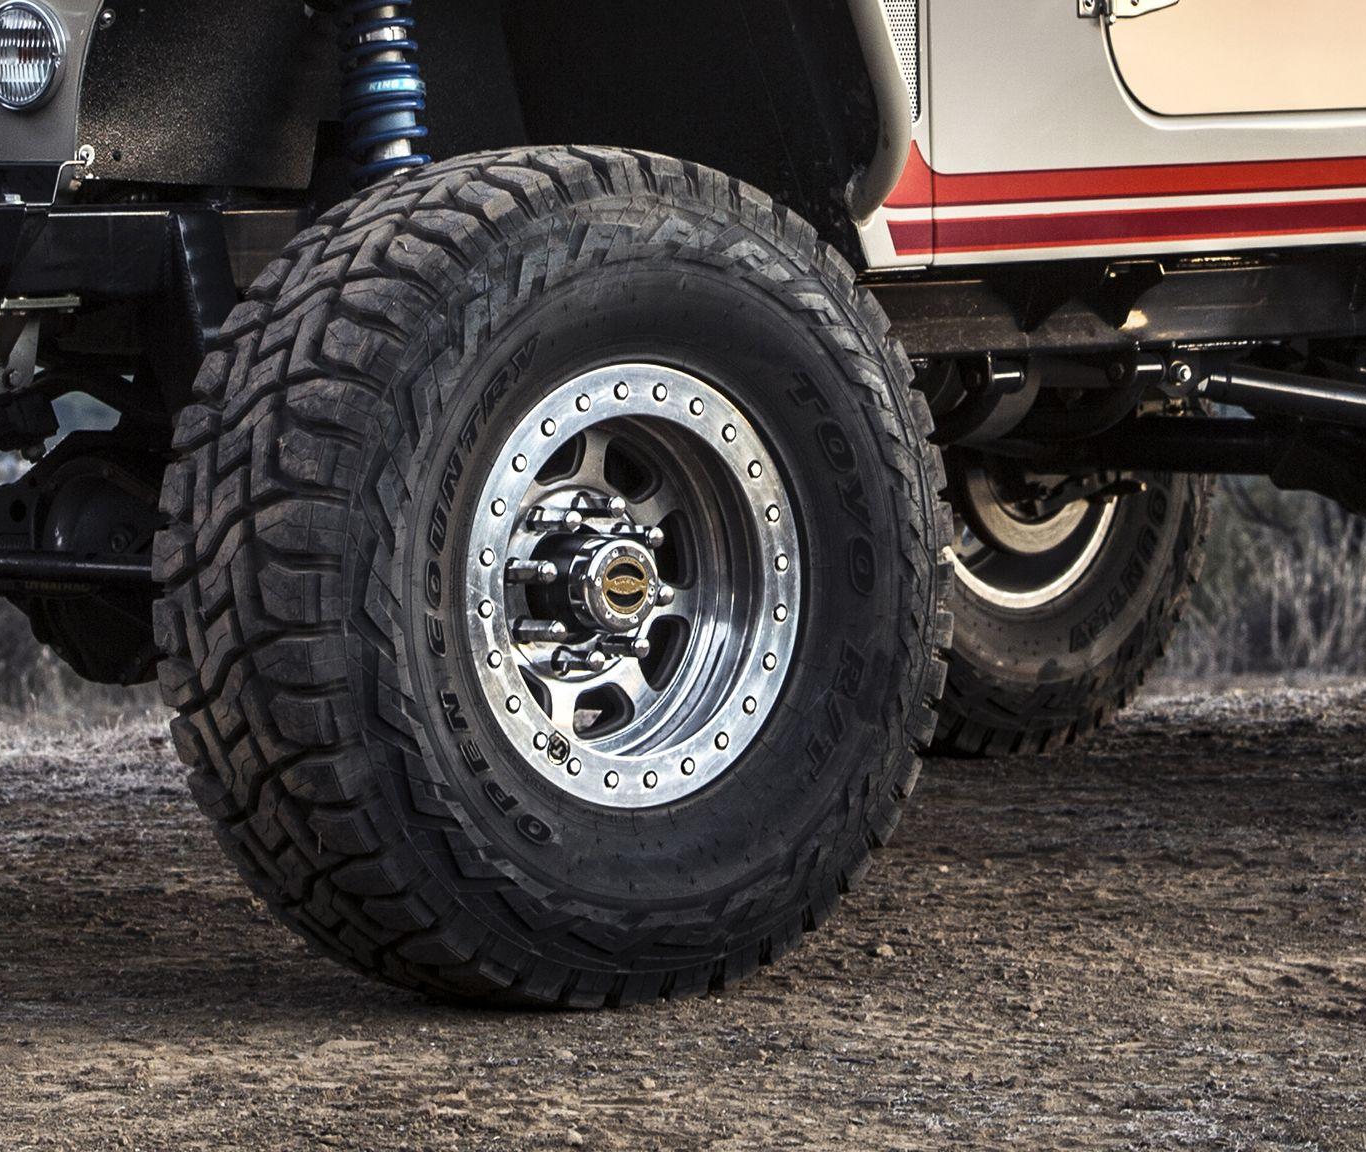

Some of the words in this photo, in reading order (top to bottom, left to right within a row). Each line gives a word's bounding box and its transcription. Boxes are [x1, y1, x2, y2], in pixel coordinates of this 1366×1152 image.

[426, 335, 538, 658] COUNTRY
[786, 371, 876, 596] TOYO
[440, 689, 552, 845] OPEN
